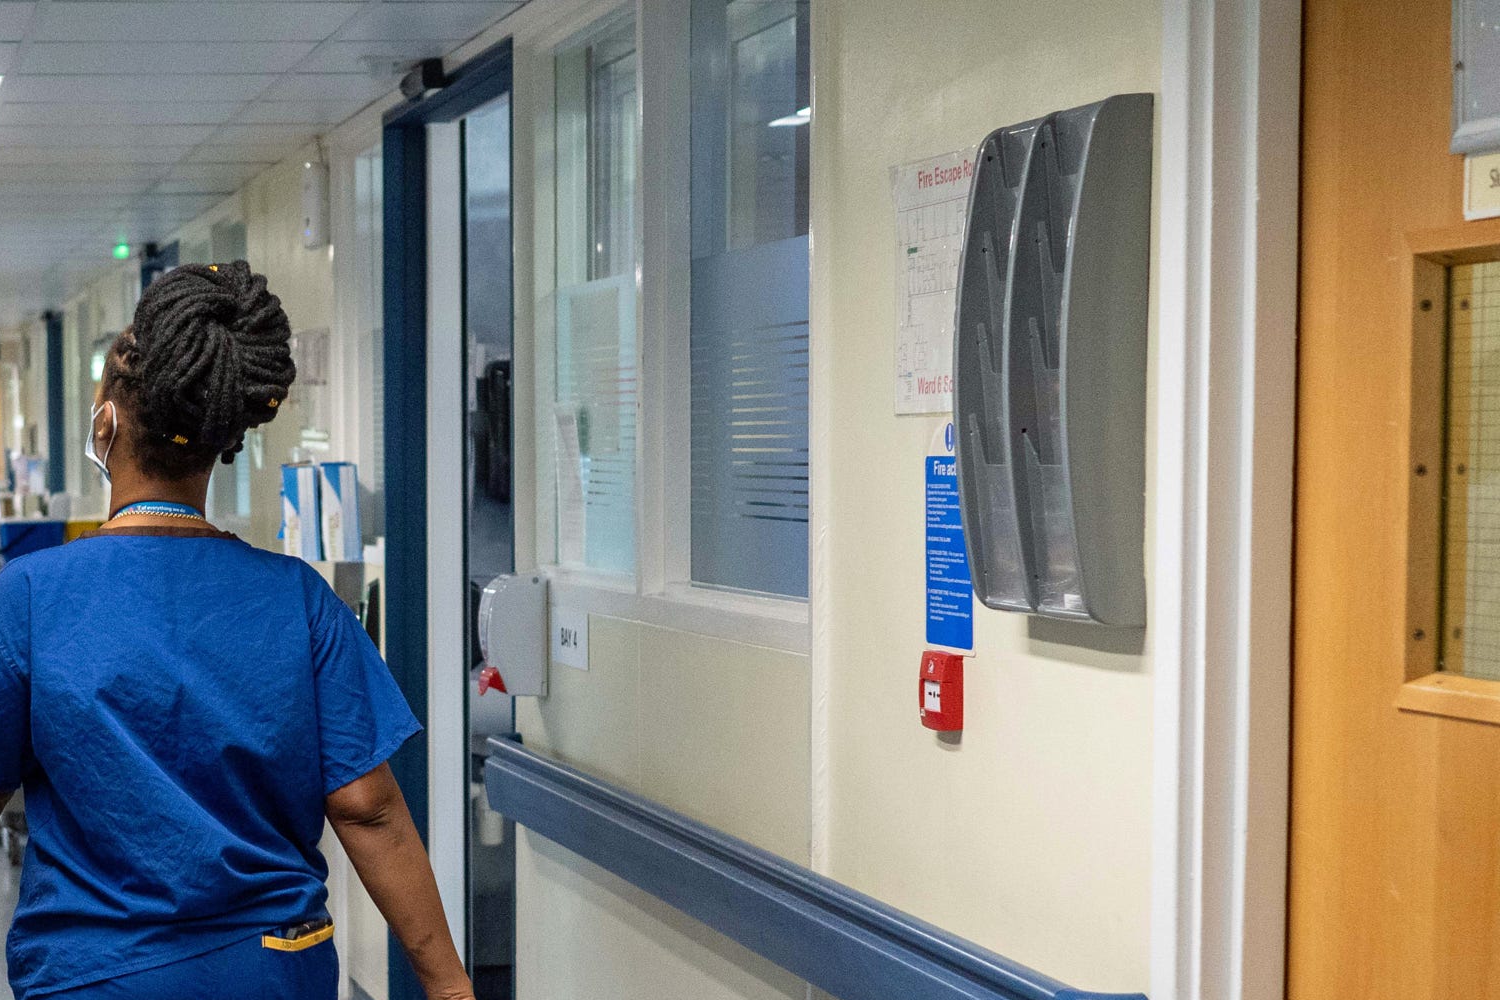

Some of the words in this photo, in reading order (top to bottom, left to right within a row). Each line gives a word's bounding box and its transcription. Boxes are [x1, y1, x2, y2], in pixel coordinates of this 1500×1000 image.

[918, 170, 933, 189] Fire
[934, 165, 961, 185] Escape
[917, 376, 937, 394] Ward
[934, 460, 947, 476] Fire
[561, 627, 572, 648] BAY
